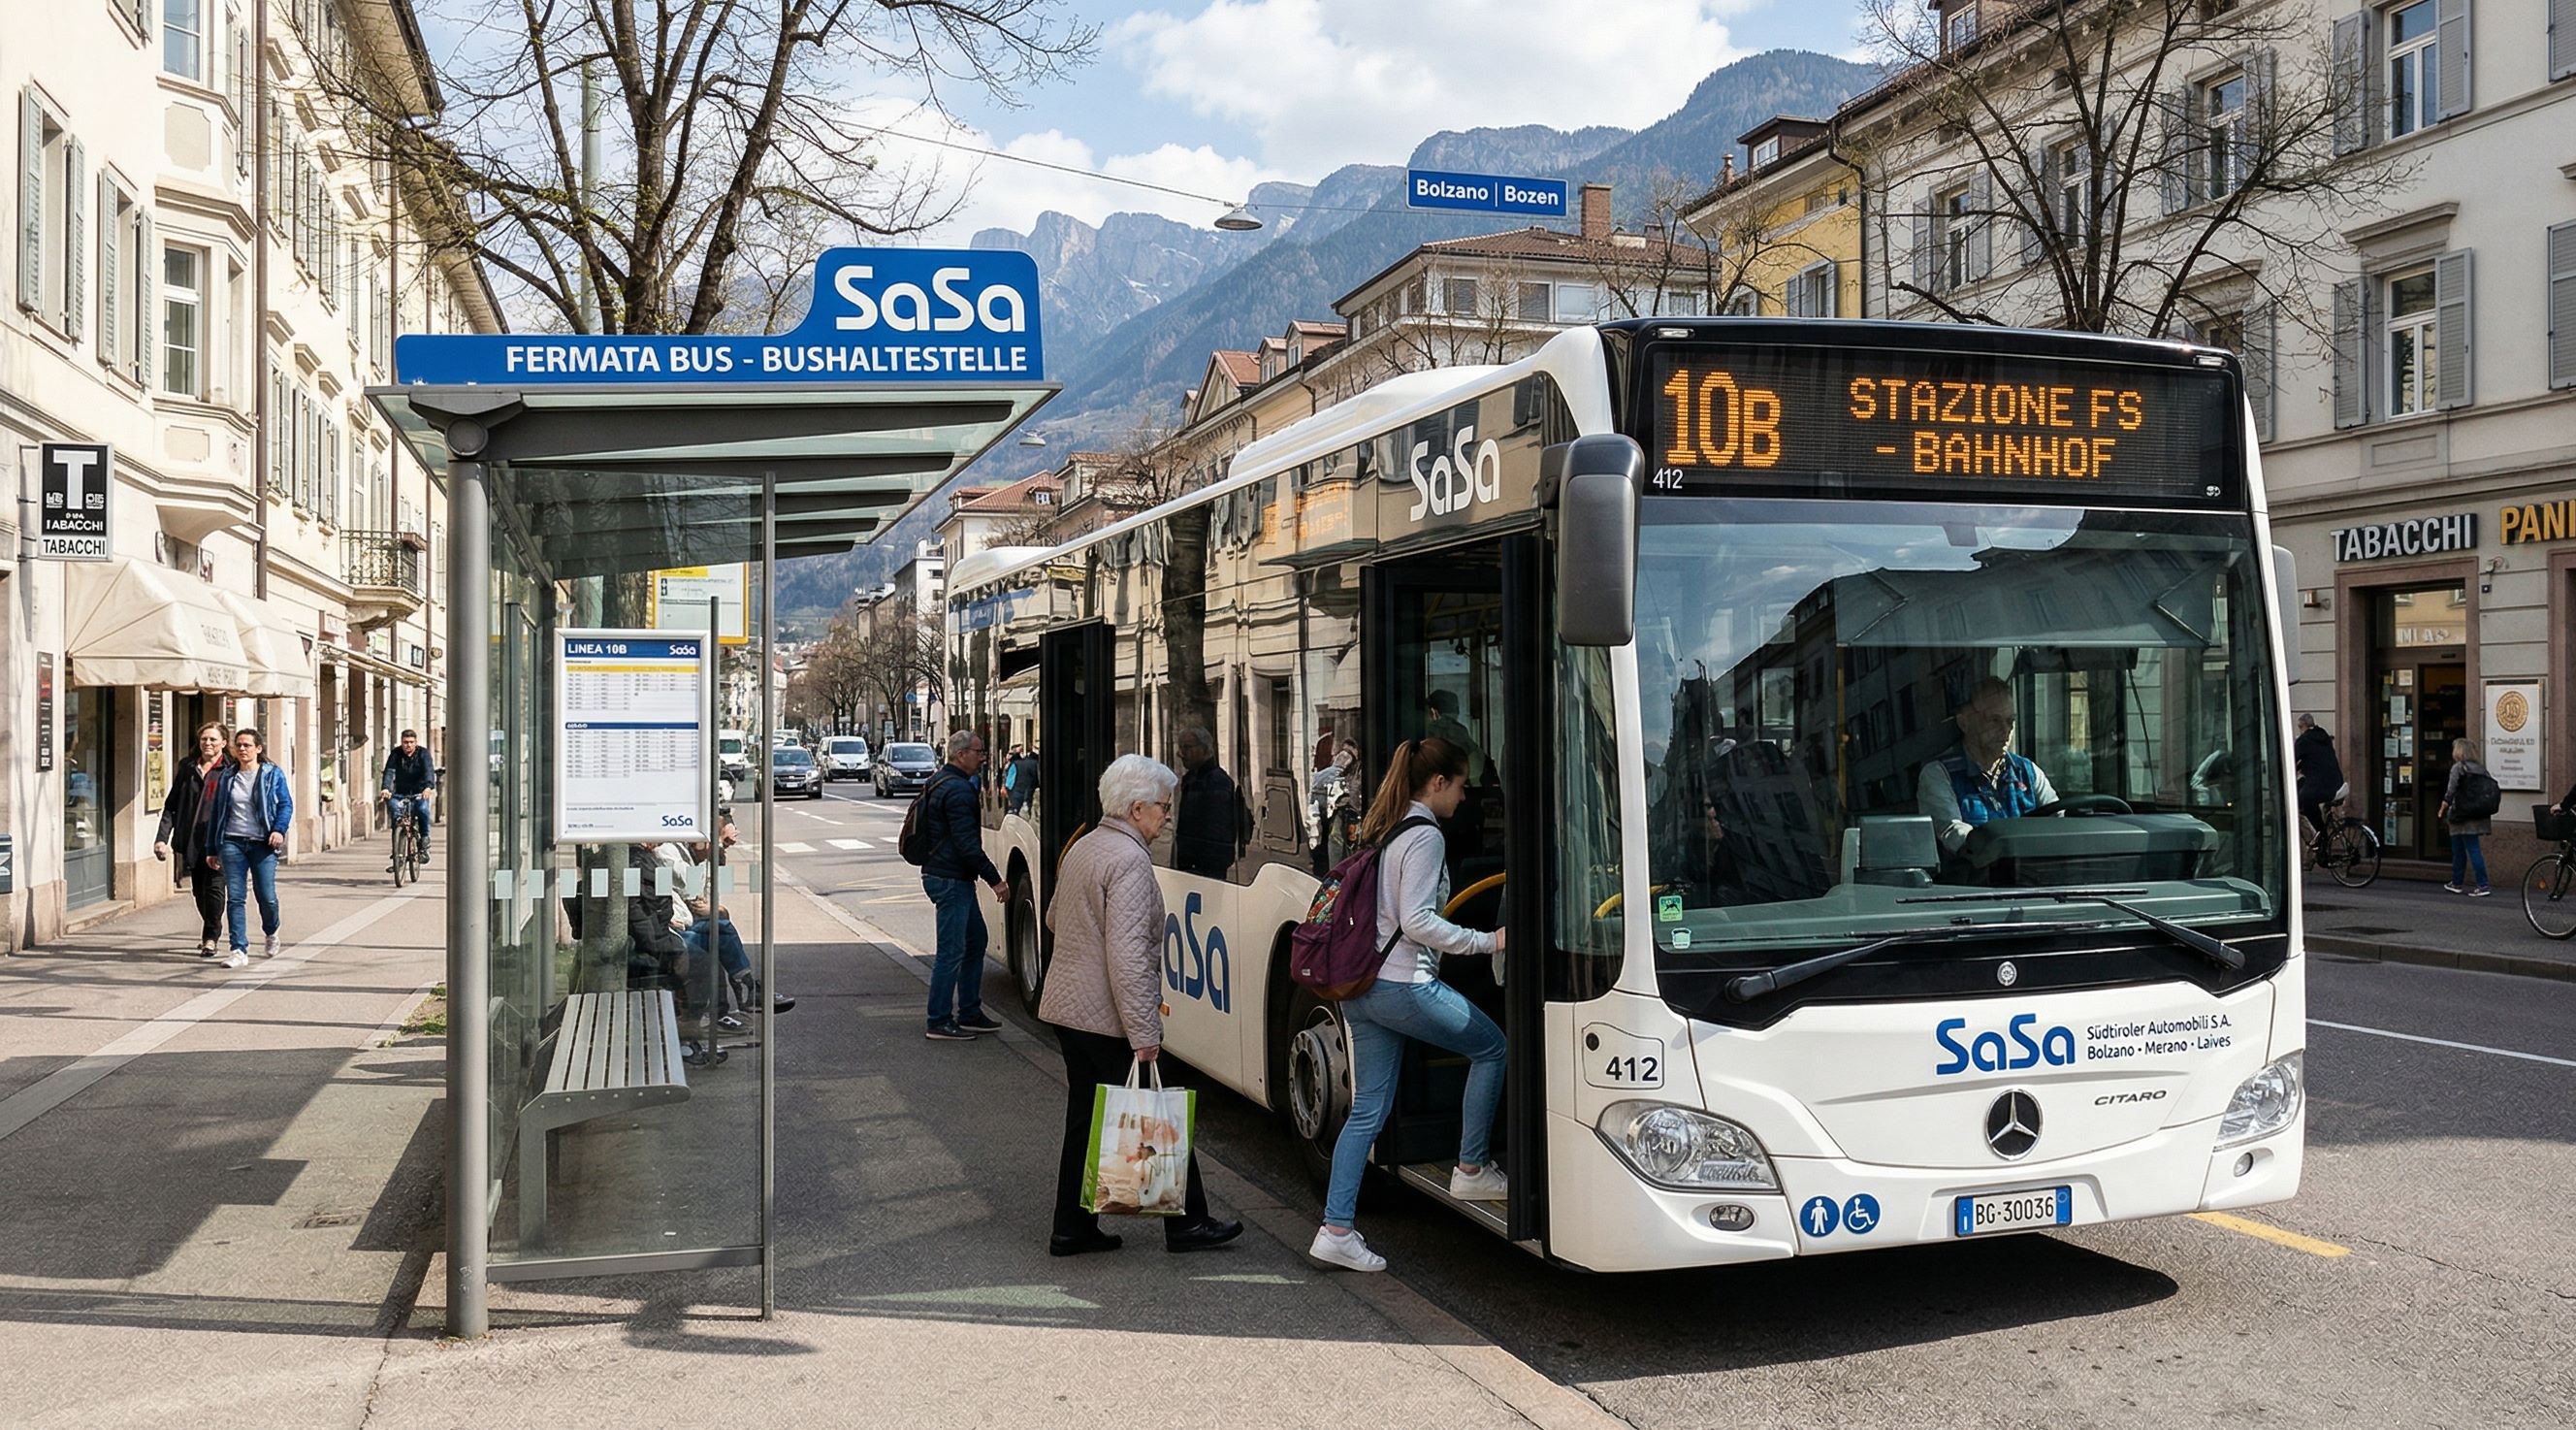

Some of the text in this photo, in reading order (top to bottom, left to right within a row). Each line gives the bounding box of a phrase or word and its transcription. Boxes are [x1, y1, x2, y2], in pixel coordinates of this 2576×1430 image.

[1416, 179, 1559, 206] Bolzano Bozen
[834, 265, 1025, 333] SaSa
[506, 346, 660, 373] FERMATA
[669, 346, 733, 373] BUS
[762, 346, 1027, 373] BUSHALTESTELLE
[1664, 369, 1781, 467] 10B
[1850, 376, 2142, 430] STAZIONE FS
[1914, 431, 2116, 477] BAHNHOF
[53, 449, 98, 509] T
[1409, 424, 1500, 522] SaSa
[1652, 468, 1684, 489] 412
[2330, 513, 2471, 562] TABACCHI
[2500, 499, 2576, 545] PANI
[43, 538, 106, 555] TABACCHI
[567, 643, 628, 655] LINEA 10B
[661, 815, 693, 827] SaSa
[1164, 892, 1231, 1015] aSa
[1936, 1013, 2076, 1075] SaSa
[2087, 1022, 2146, 1041] Südtiroler
[2147, 1015, 2208, 1035] Automobili
[2087, 1043, 2135, 1060] Bolzano
[2197, 1033, 2232, 1050] Laives
[1605, 1056, 1658, 1082] 412
[2094, 1089, 2168, 1106] CITARO
